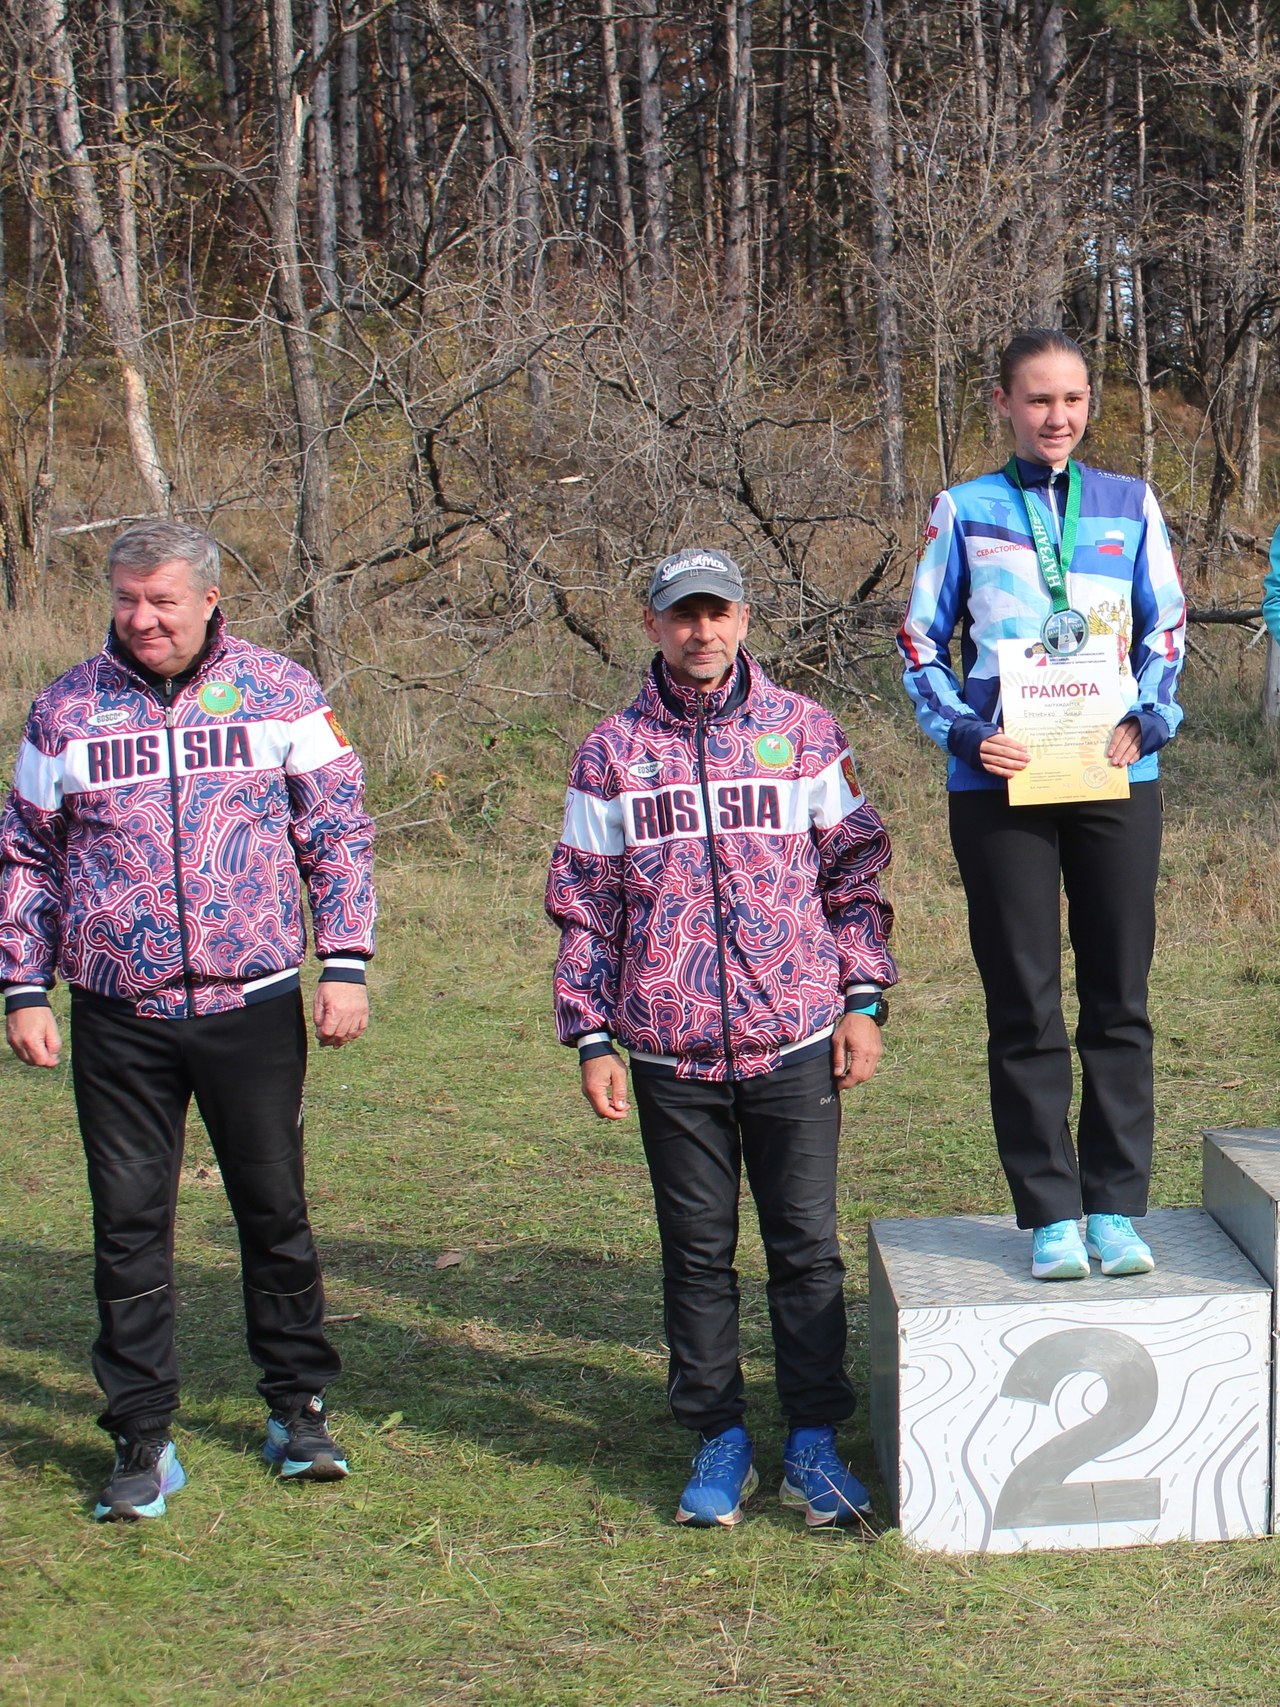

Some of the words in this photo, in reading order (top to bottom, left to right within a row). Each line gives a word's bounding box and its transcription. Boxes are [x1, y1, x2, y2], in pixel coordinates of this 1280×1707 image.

[662, 559, 690, 579] South
[691, 555, 725, 569] Africa
[1033, 522, 1062, 588] НАРЗАН
[1021, 683, 1100, 699] ГРАМОТА
[994, 1328, 1161, 1530] 2
